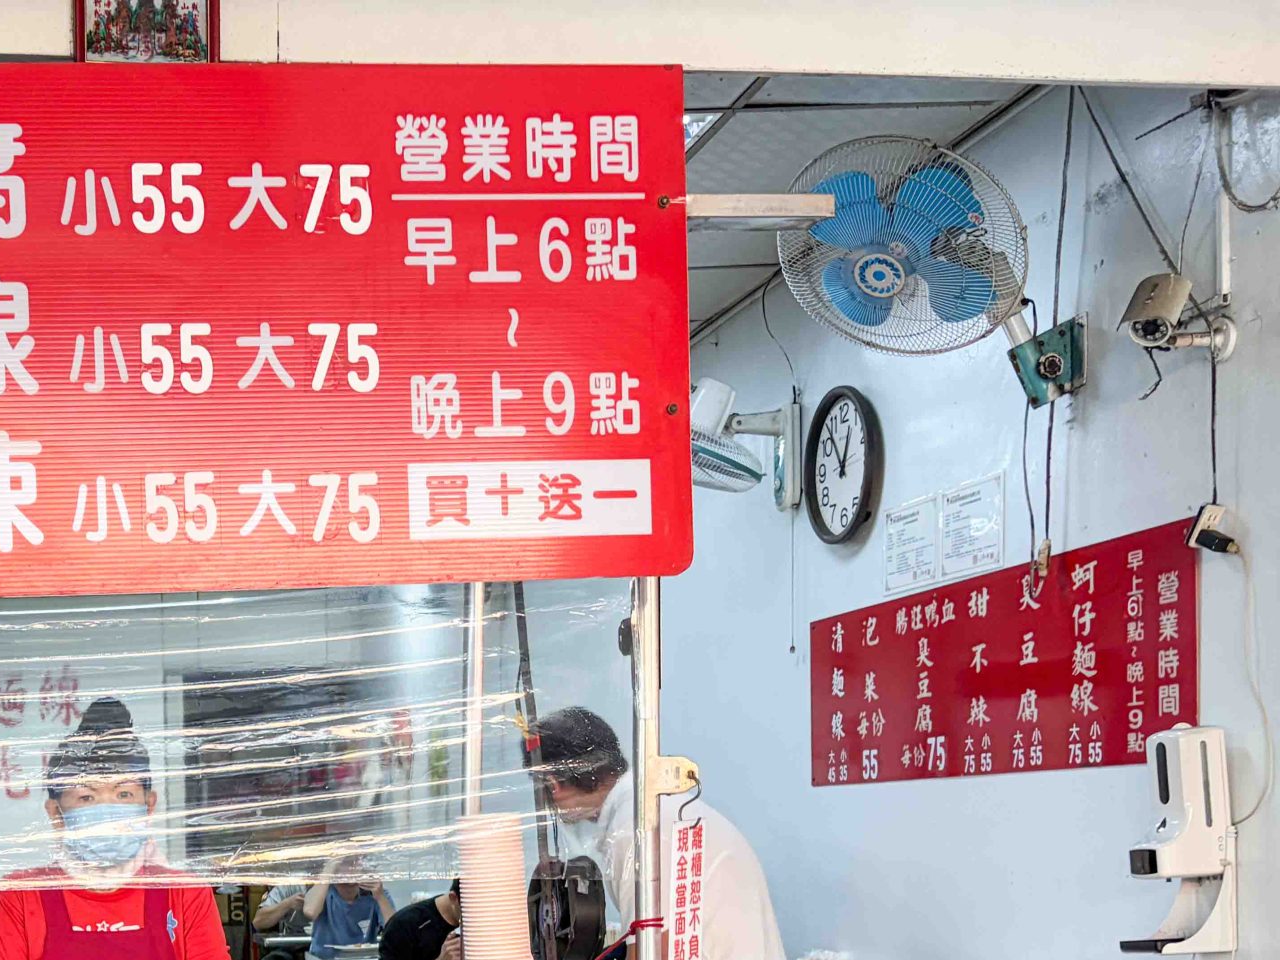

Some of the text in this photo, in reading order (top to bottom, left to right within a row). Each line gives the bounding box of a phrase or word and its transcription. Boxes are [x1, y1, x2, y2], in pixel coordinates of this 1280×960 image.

[396, 114, 640, 182] 營業時間
[404, 216, 637, 285] 早上6點
[410, 371, 641, 438] 晚上9點
[839, 402, 850, 424] 12
[819, 463, 826, 483] 9
[424, 472, 639, 527] 買十送一
[822, 486, 829, 506] 8
[829, 503, 837, 524] 7
[841, 507, 849, 528] 6
[862, 616, 880, 703] 泡菜
[967, 587, 991, 728] 甜不辣
[1016, 574, 1041, 723] 臭豆腐
[1070, 560, 1099, 718] 蚵仔麵線
[1158, 570, 1180, 717] 營業時間
[830, 621, 846, 742] 清麵線
[914, 637, 934, 734] 臭豆腐
[857, 708, 886, 780] 每份 55
[901, 735, 945, 771] 每份 75
[964, 754, 976, 773] 75
[980, 752, 992, 772] 55
[1012, 748, 1025, 769] 75
[1030, 745, 1043, 766] 55
[1069, 743, 1082, 764] 75
[1088, 741, 1102, 763] 55
